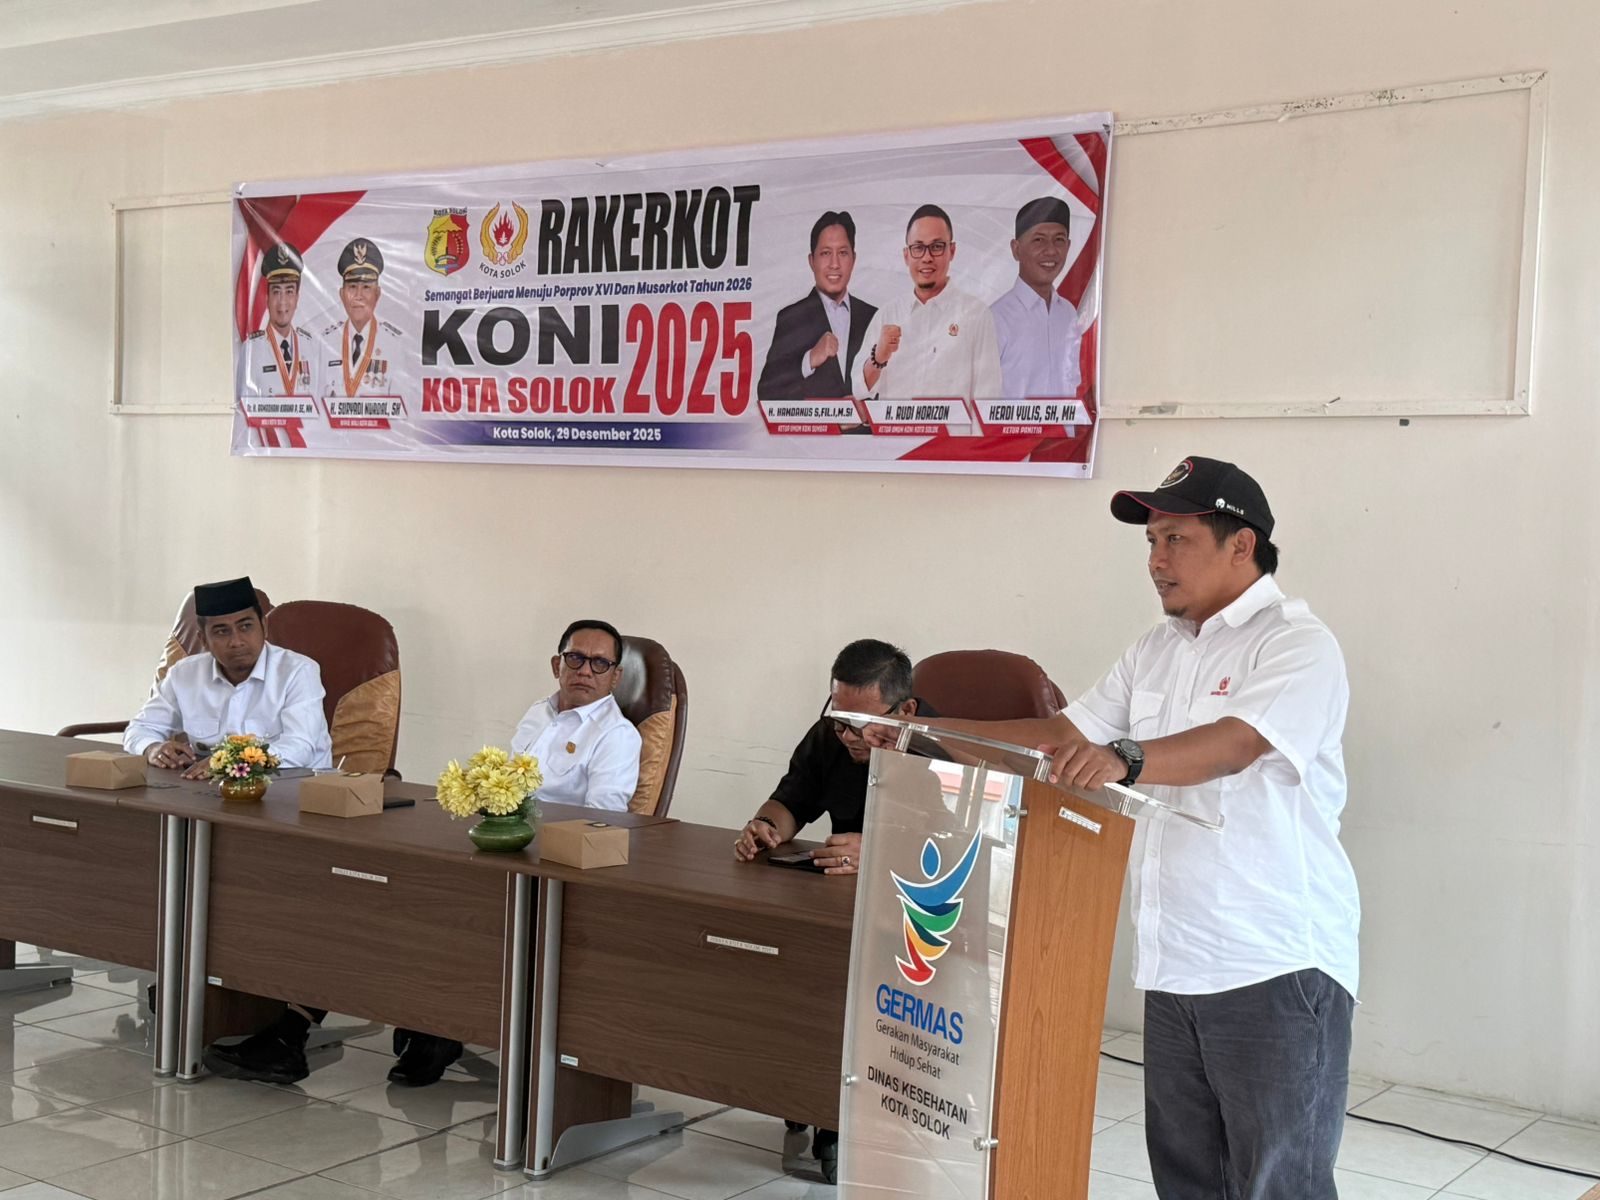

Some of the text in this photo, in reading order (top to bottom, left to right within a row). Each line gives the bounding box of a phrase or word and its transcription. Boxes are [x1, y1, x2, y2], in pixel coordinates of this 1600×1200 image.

[537, 184, 760, 276] RAKERKOT
[479, 260, 526, 279] KOTA SOLOK
[424, 277, 752, 304] Semangat Berjuara Menuju Porprov XVI Dan Musorkot Tahun 2026
[421, 301, 752, 416] KONI 2025
[421, 376, 617, 414] KOTA SOLOK
[768, 407, 775, 417] H.
[776, 407, 813, 417] HAMDANUS
[885, 405, 950, 421] H. RUDI HORIZON
[989, 405, 1076, 423] HERDI YULIS, SH, MH
[493, 427, 661, 442] Kota Solok, 29 Desember 2025
[876, 983, 963, 1045] GERMAS
[876, 1018, 960, 1066] Gerakan Masyarakat
[890, 1045, 941, 1079] Hidup Sehat
[867, 1065, 967, 1125] DINAS KESEHATAN
[881, 1093, 950, 1140] KOTA SOLOK
